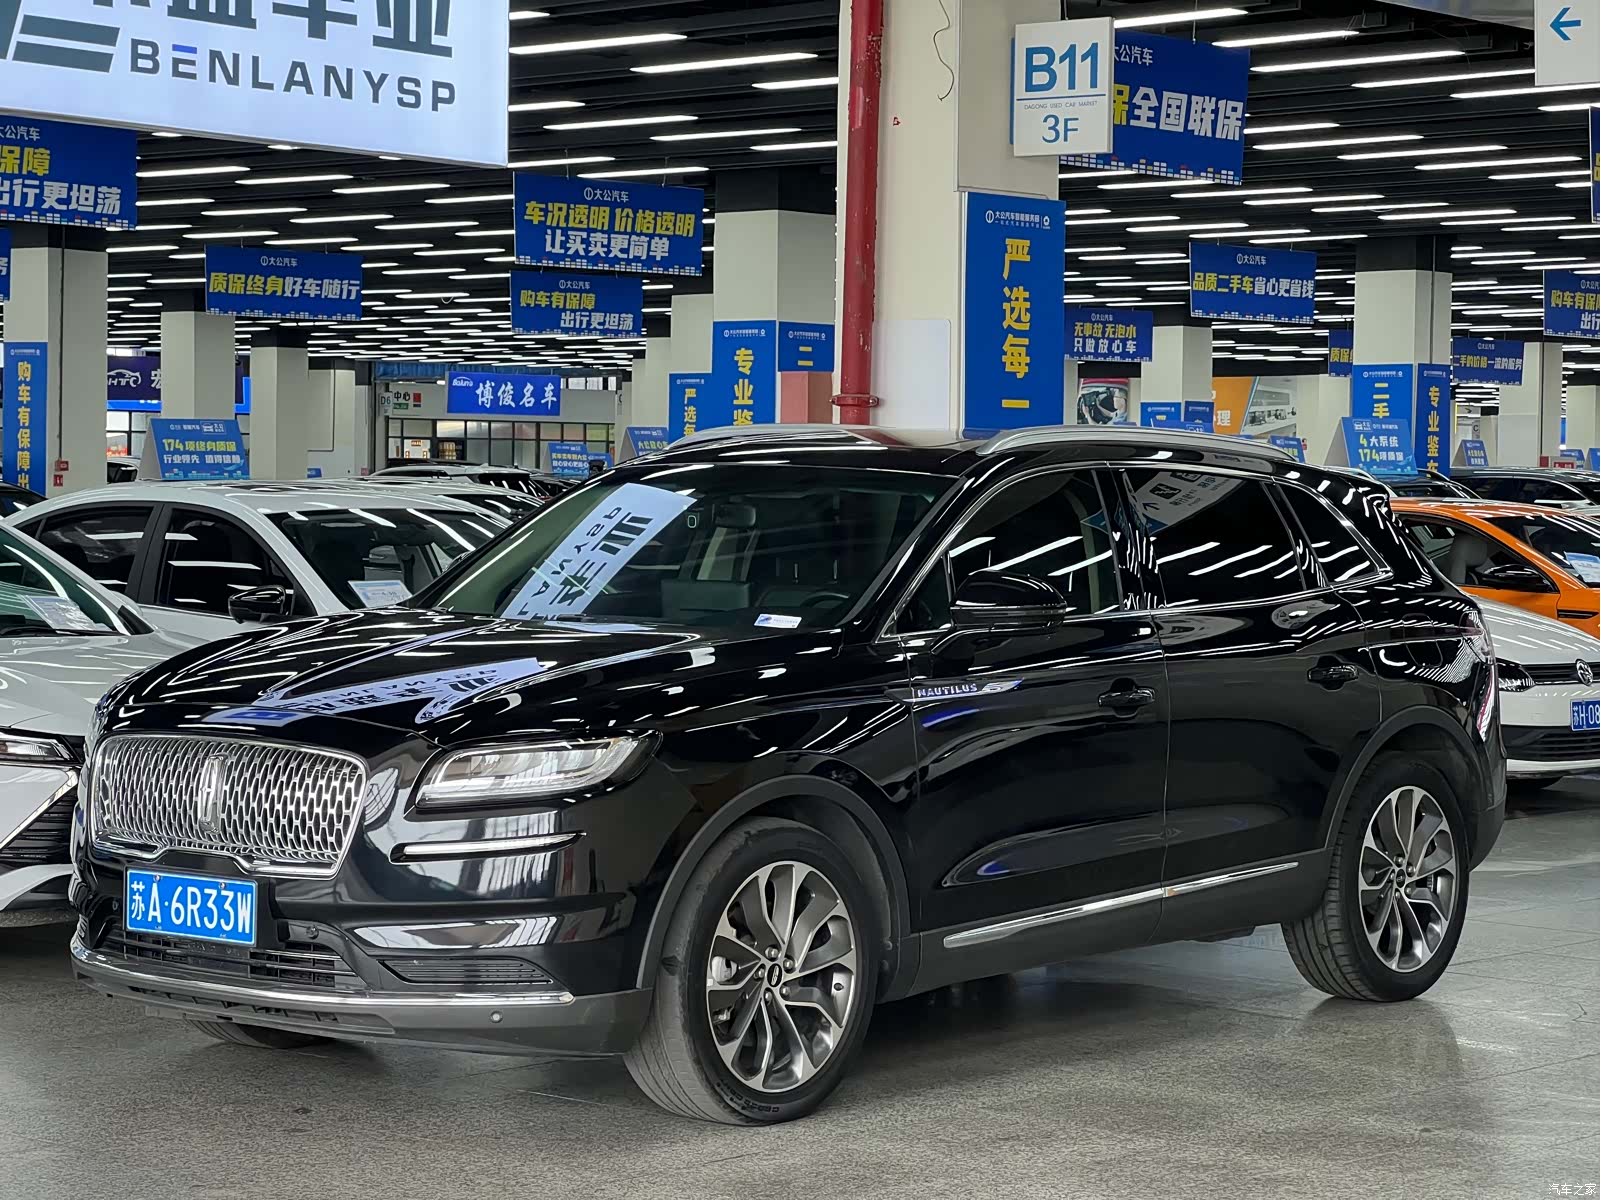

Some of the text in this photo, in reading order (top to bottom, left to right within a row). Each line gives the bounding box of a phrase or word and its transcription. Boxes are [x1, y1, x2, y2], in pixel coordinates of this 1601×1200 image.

[130, 37, 456, 112] BENLANYSP
[1024, 42, 1099, 93] B11
[1042, 114, 1079, 143] 3F
[594, 189, 629, 203] 大公汽车
[524, 201, 696, 237] 车况透明 价格透明
[545, 229, 670, 261] 让买卖更简单
[268, 257, 298, 267] 大公汽车
[1243, 255, 1267, 265] 大公汽车
[208, 272, 361, 300] 质保终身好车随行
[566, 280, 591, 289] 大公汽车
[1193, 272, 1314, 298] 品质二手车省心更省钱
[520, 289, 596, 310] 购车有保障
[560, 311, 634, 330] 出行更坦荡
[1002, 238, 1031, 408] 严选每一
[475, 380, 557, 410] 博俊名车
[1372, 382, 1390, 419] 二手
[917, 683, 978, 697] NAUTILUS
[131, 881, 251, 934] 苏A·6R33W
